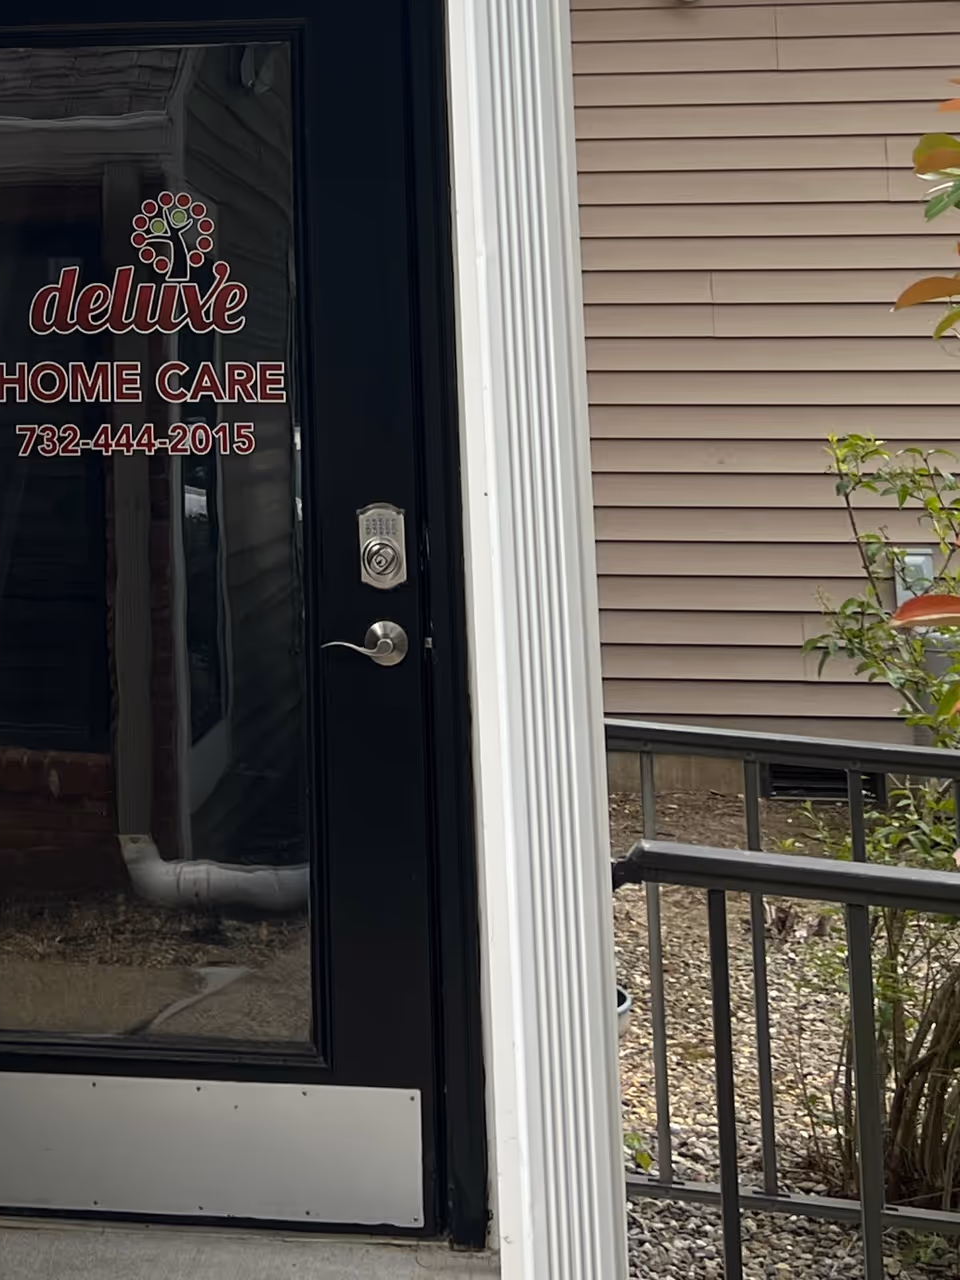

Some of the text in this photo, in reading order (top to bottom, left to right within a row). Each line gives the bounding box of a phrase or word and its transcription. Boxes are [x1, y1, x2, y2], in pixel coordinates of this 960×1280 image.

[29, 261, 248, 335] deluxe
[155, 361, 287, 403] CARE
[15, 422, 256, 457] 732-444-2015
